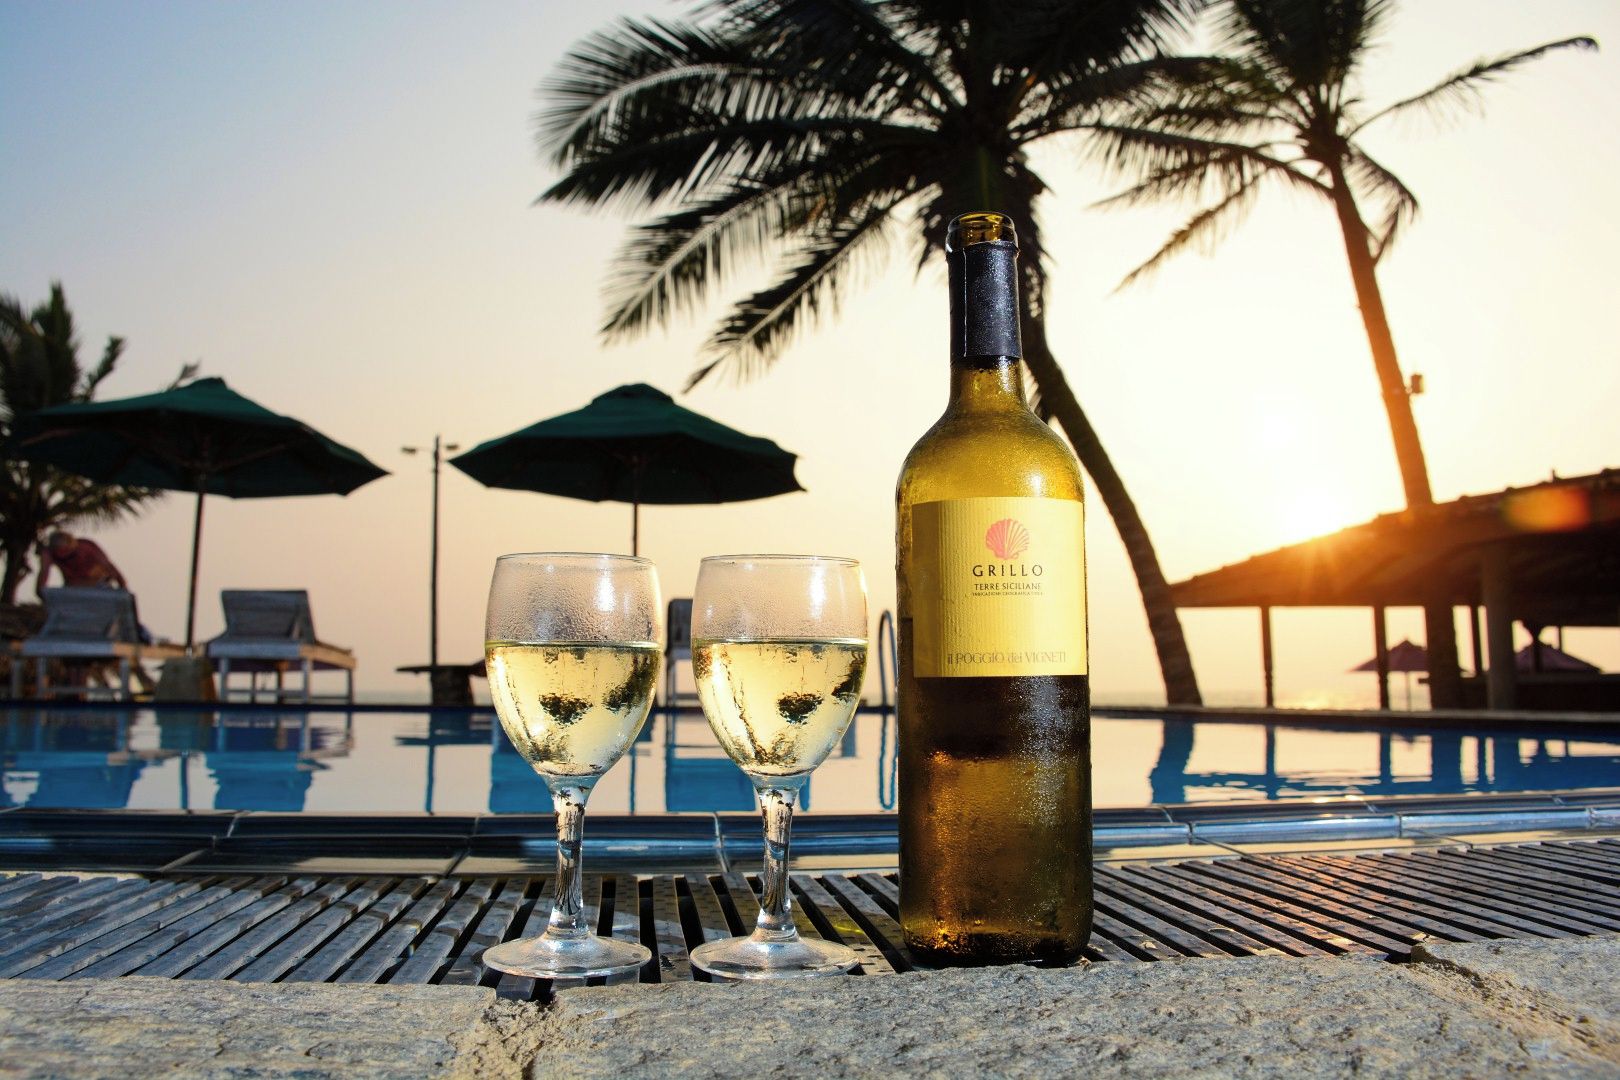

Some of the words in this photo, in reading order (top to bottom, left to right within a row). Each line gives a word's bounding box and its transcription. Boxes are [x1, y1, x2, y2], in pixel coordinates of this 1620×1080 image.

[972, 564, 1043, 577] GRILLO
[974, 583, 1000, 591] TERRE
[956, 652, 1005, 665] POGGIO
[1007, 651, 1023, 663] dei
[1024, 651, 1067, 663] VIGNETI
